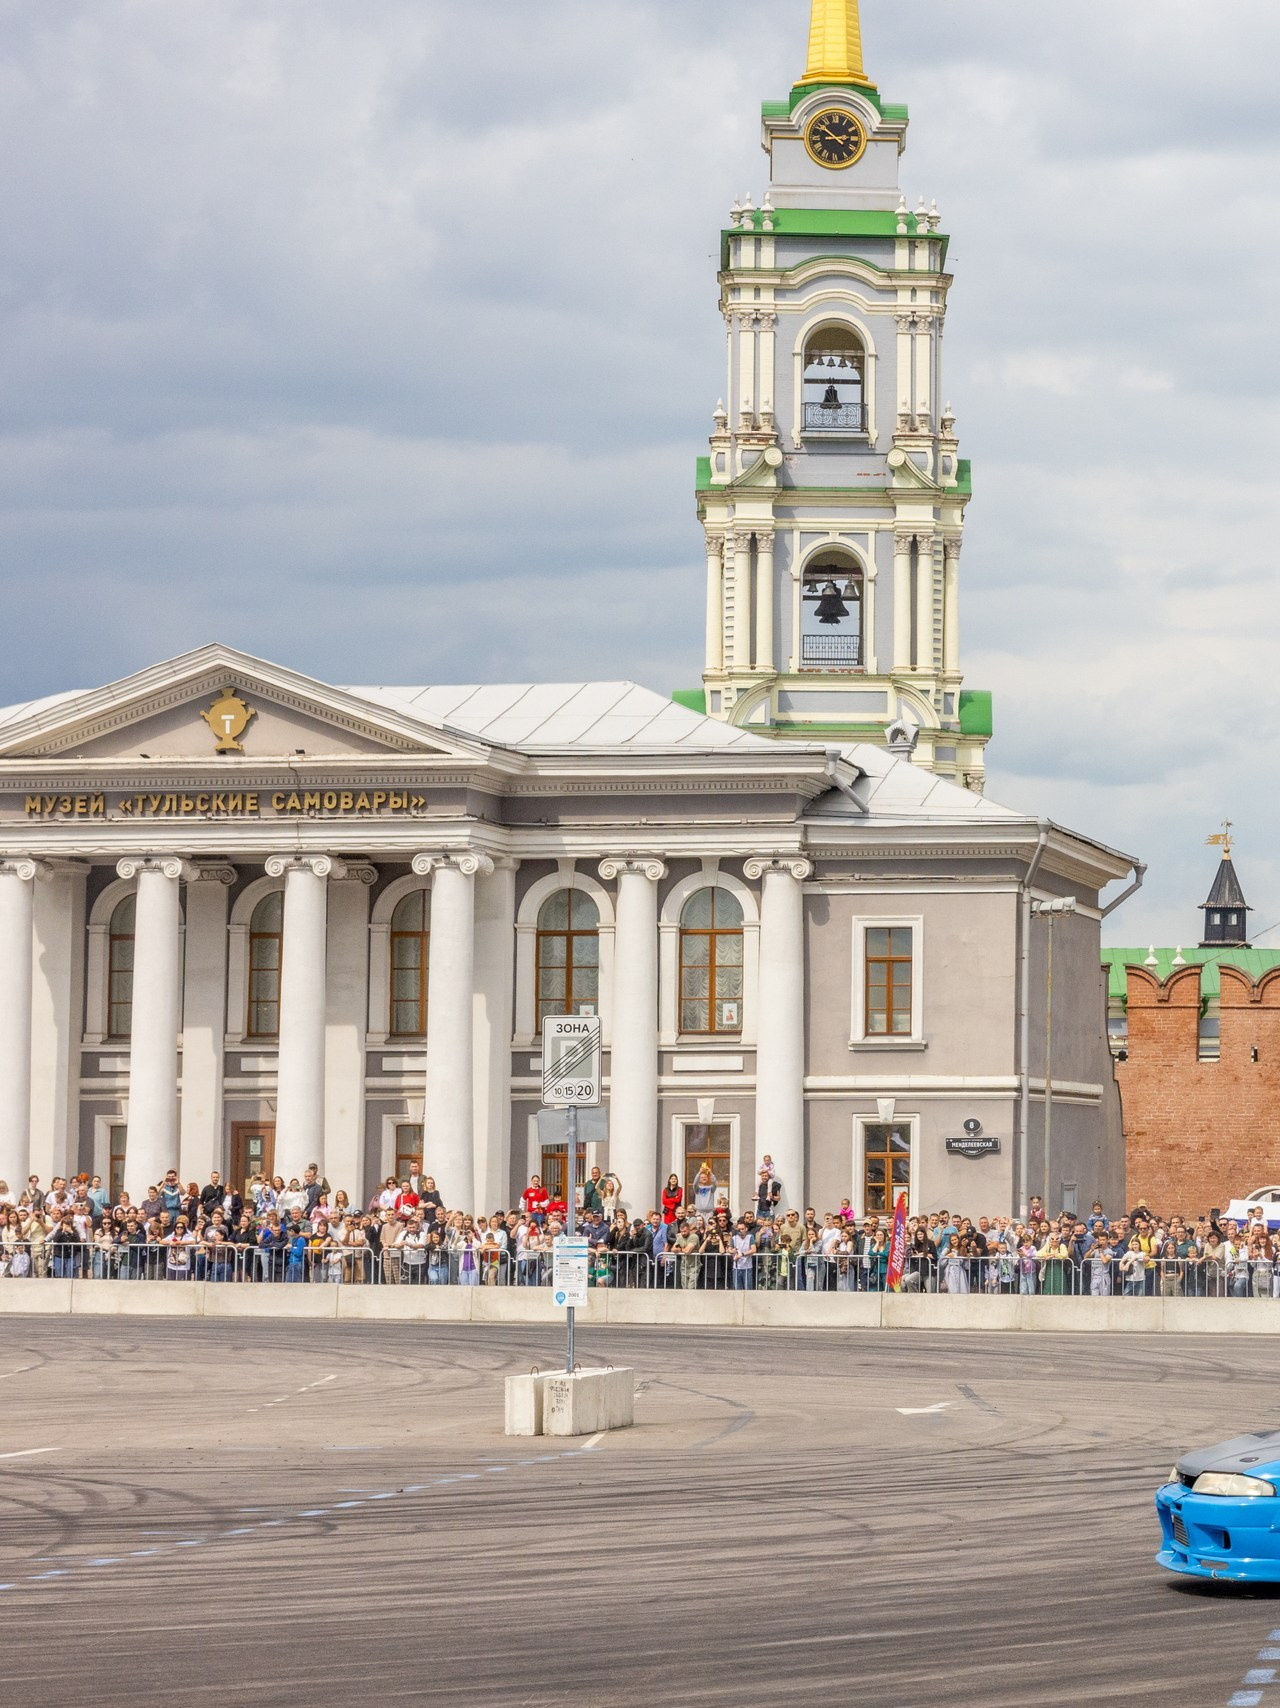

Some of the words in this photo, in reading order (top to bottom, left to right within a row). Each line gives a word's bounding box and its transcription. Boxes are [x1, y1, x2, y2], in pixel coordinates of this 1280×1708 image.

[25, 791, 105, 813] МУЗЕЙ
[118, 793, 258, 813] «ТУЛЬСКИЕ
[271, 791, 426, 810] САМОВАРЫ»
[556, 1023, 590, 1033] ЗОНА
[554, 1087, 562, 1095] 10
[565, 1086, 574, 1096] 15
[577, 1085, 592, 1096] 20
[969, 1121, 975, 1129] 8
